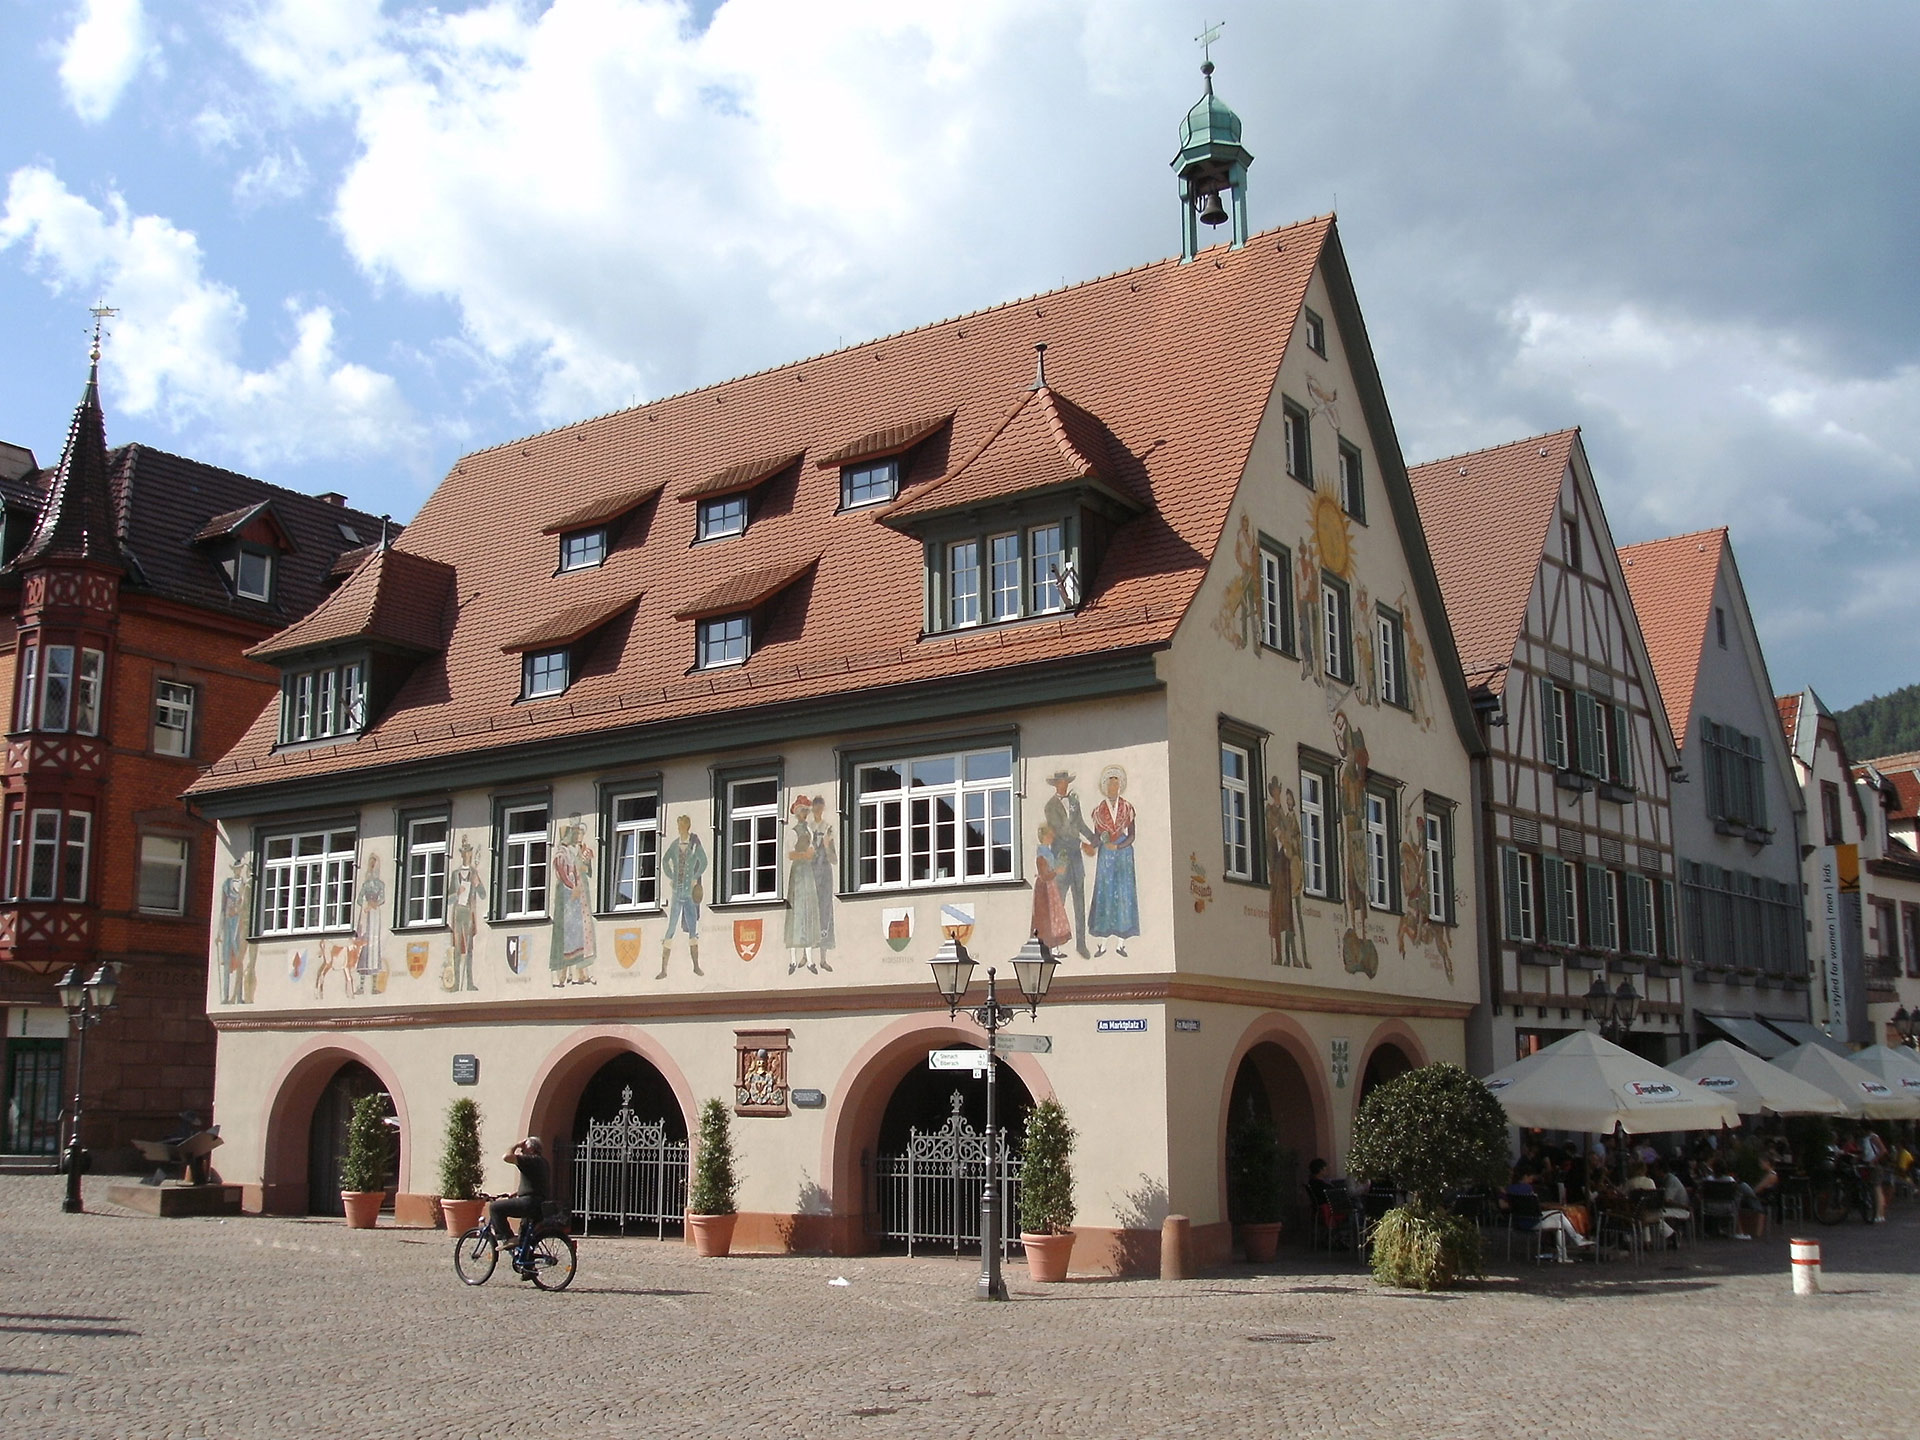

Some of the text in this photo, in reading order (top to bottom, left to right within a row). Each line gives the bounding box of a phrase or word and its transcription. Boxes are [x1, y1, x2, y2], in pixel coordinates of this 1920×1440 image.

[1822, 864, 1842, 1008] styled for women men kids
[1099, 1021, 1108, 1030] Am
[1109, 1020, 1140, 1031] Marktplatz
